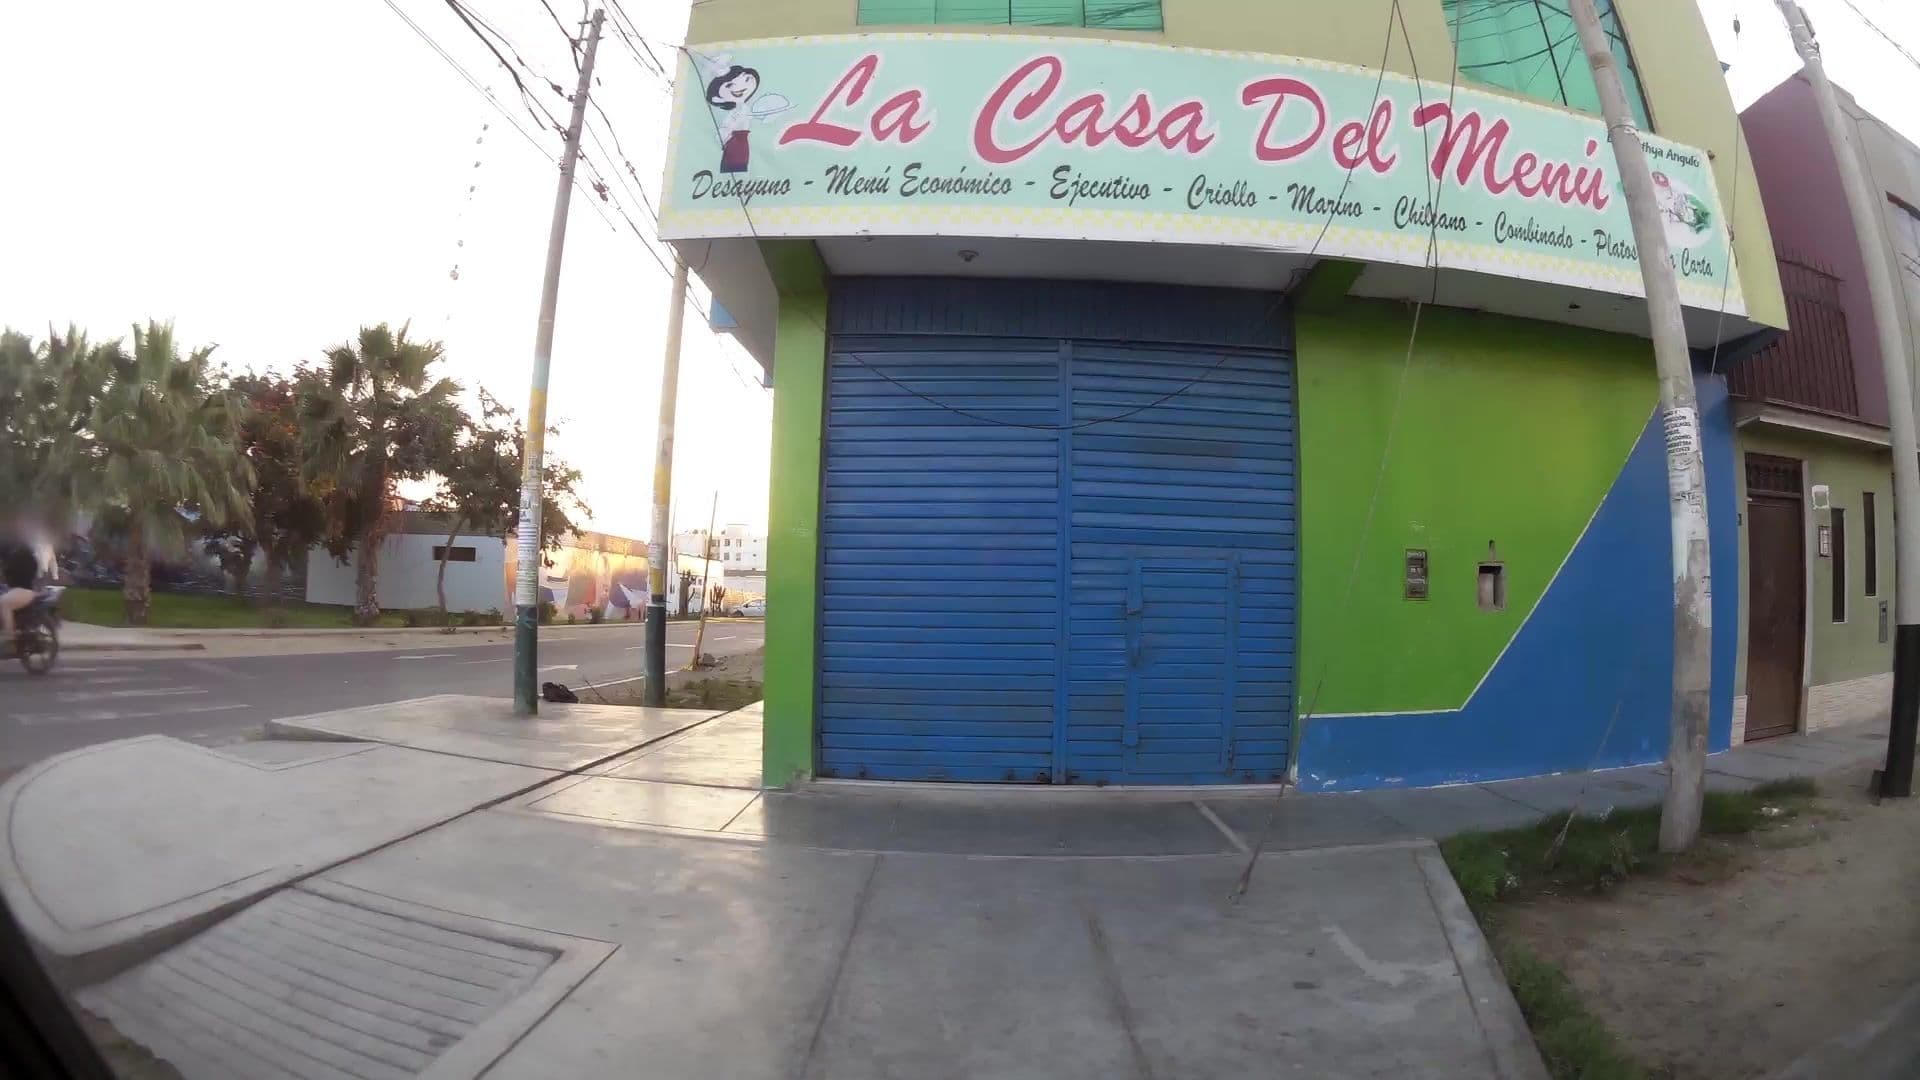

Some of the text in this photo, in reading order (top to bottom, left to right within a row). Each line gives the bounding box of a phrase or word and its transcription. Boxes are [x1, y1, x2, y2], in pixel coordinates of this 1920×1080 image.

[778, 54, 1609, 210] La Casa Del Menú
[1666, 149, 1700, 168] Angulo
[692, 169, 791, 208] Desayuno
[825, 163, 890, 196] Menú
[900, 162, 1012, 197] Económico
[1050, 164, 1152, 207] Ejecutivo
[1187, 174, 1258, 210] Criollo
[1287, 182, 1363, 217] Marino
[1494, 210, 1574, 248] Combinado
[1593, 228, 1638, 261] Platos
[1681, 247, 1713, 276] Carta
